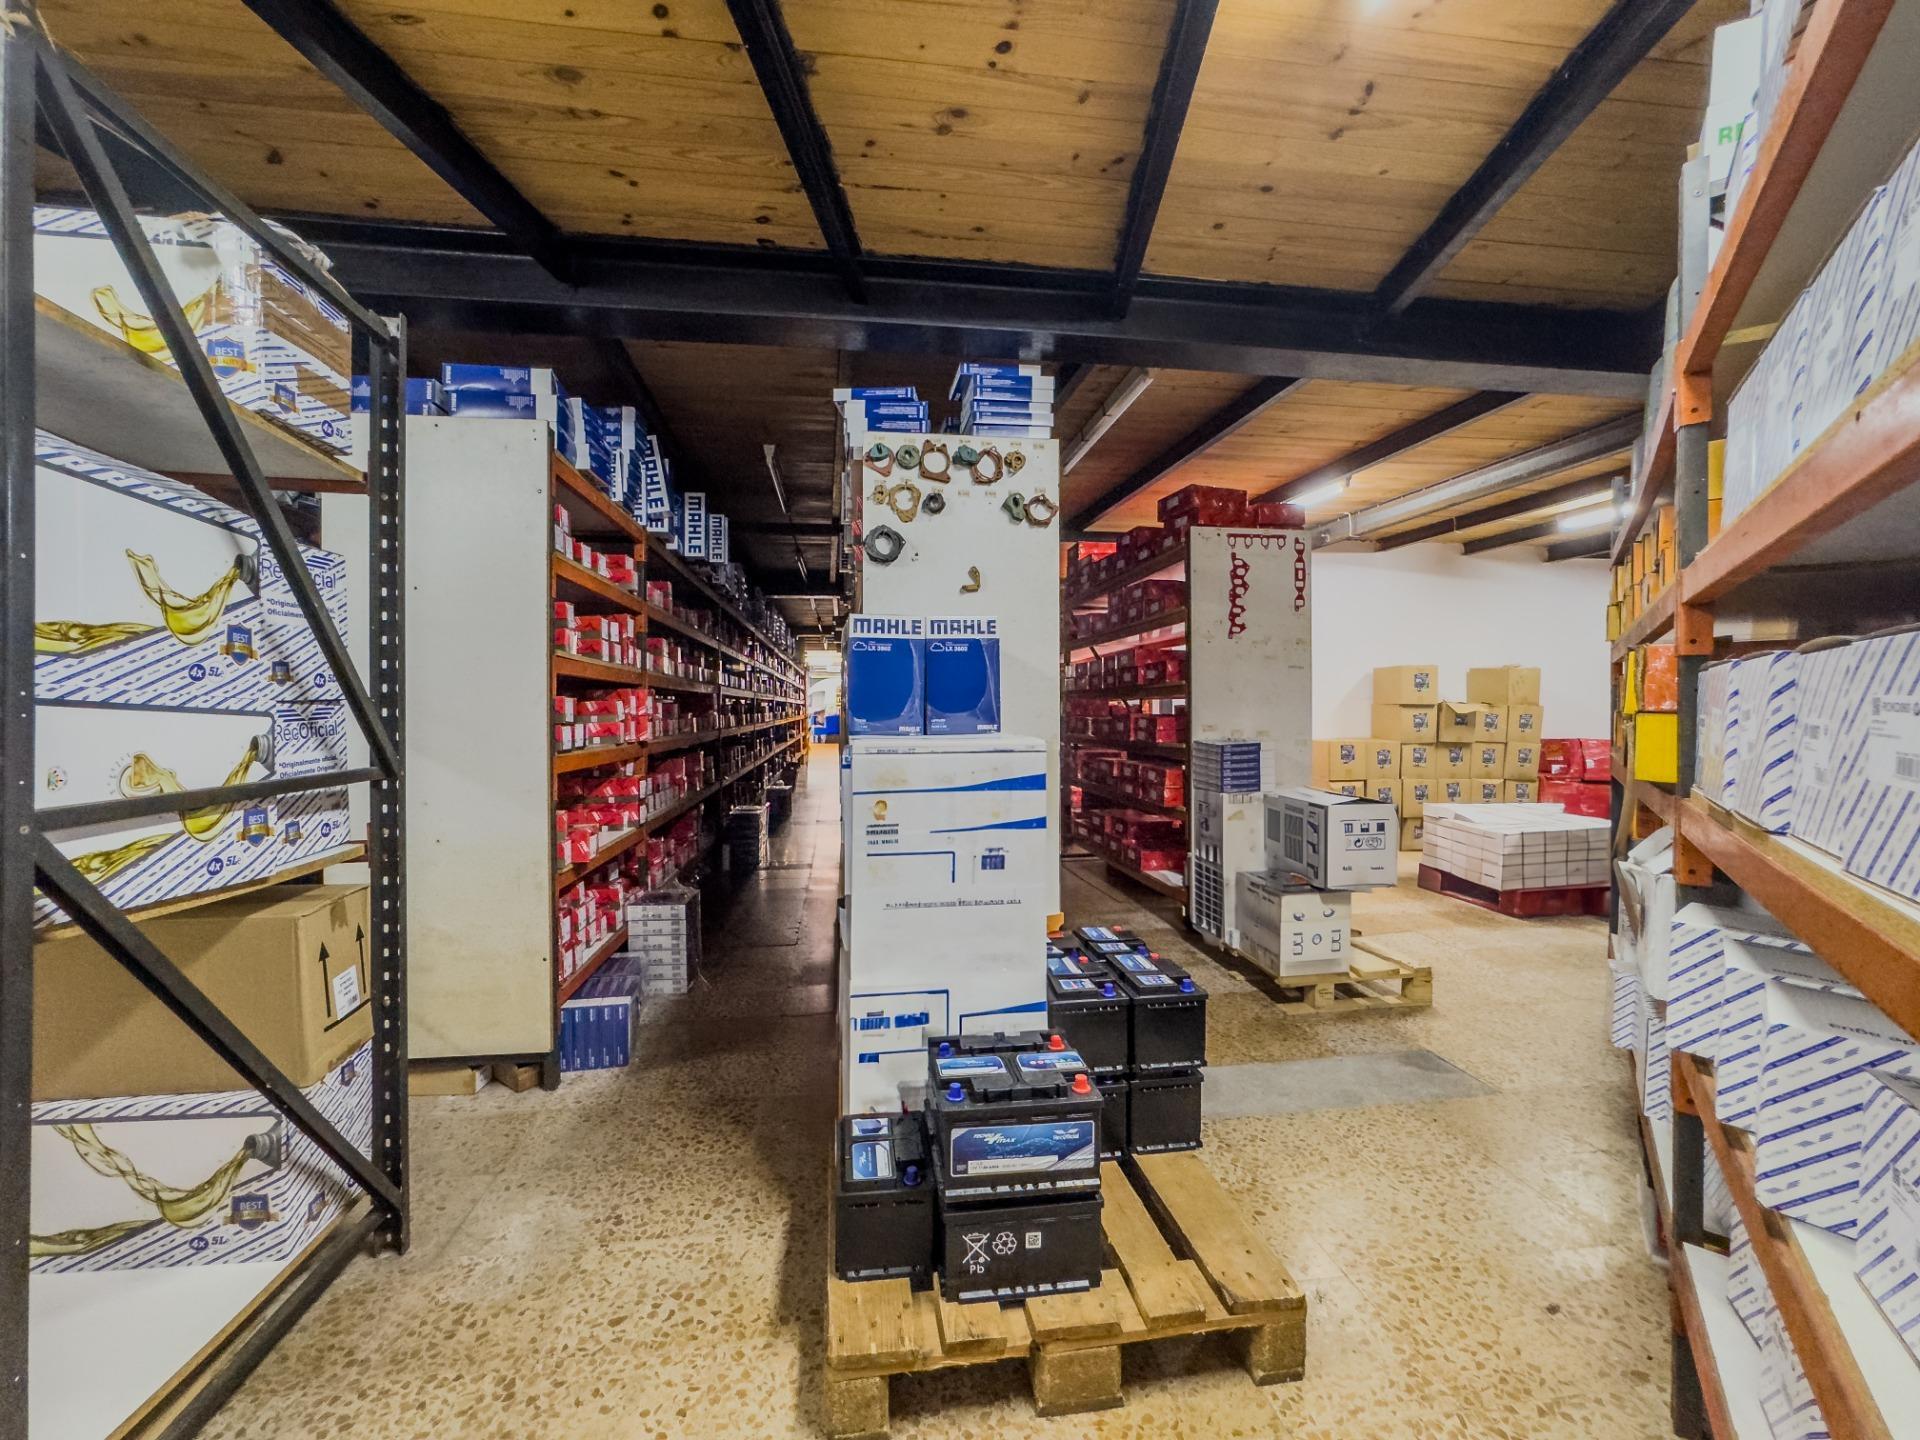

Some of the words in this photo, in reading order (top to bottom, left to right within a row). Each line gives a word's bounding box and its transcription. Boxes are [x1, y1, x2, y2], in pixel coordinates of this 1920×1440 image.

[214, 347, 239, 357] BEST
[688, 495, 702, 555] MAHLE
[711, 516, 723, 560] MAHLE
[267, 609, 306, 619] Oficialmen
[853, 618, 922, 635] MAHLE
[930, 619, 997, 635] MAHLE
[232, 632, 249, 643] BEST
[190, 667, 205, 678] 4x
[276, 721, 339, 742] RecOficial
[248, 814, 265, 824] BEST
[208, 861, 222, 872] 4x
[240, 1201, 263, 1210] BEST
[190, 1238, 207, 1249] 4x
[969, 1264, 985, 1275] Pb
